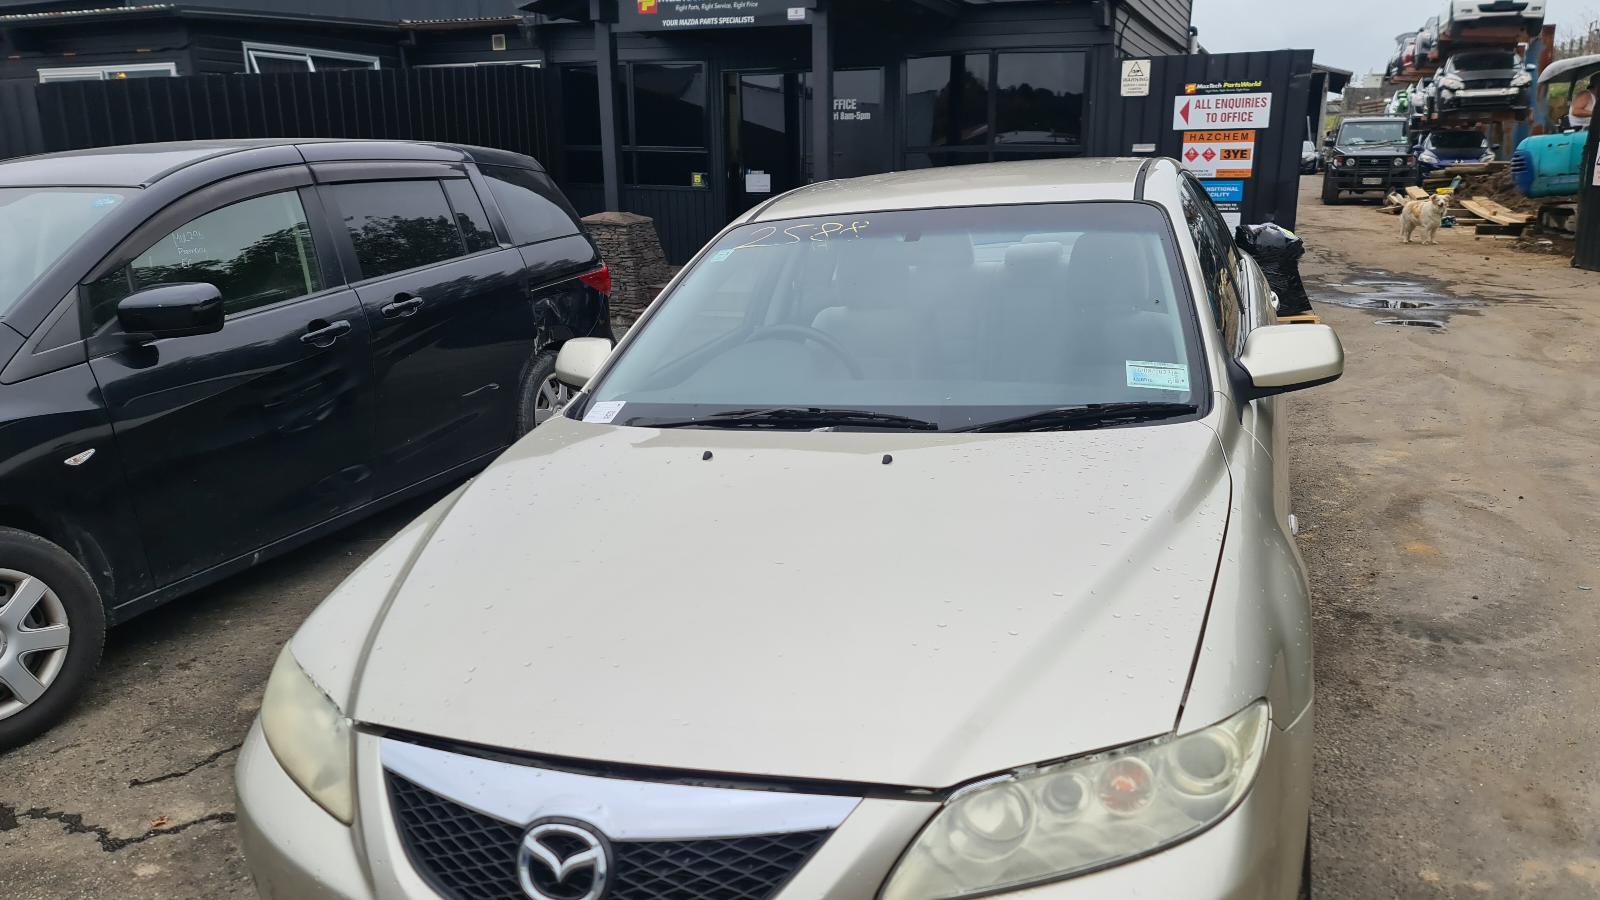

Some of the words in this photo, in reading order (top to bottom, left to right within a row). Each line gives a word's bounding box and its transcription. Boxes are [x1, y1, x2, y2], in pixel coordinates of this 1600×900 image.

[679, 18, 699, 26] MAZDA
[699, 17, 718, 25] PARTS
[719, 16, 755, 24] SPECIALISTS
[833, 98, 857, 110] FFICE
[1194, 98, 1211, 109] ALL
[1215, 97, 1267, 109] ENQUIRIES
[840, 112, 871, 120] 8am-5pm
[1206, 112, 1217, 123] TO
[1220, 112, 1254, 122] OFFICE
[1189, 133, 1249, 141] HAZCHEM
[1223, 149, 1248, 159] 3YE
